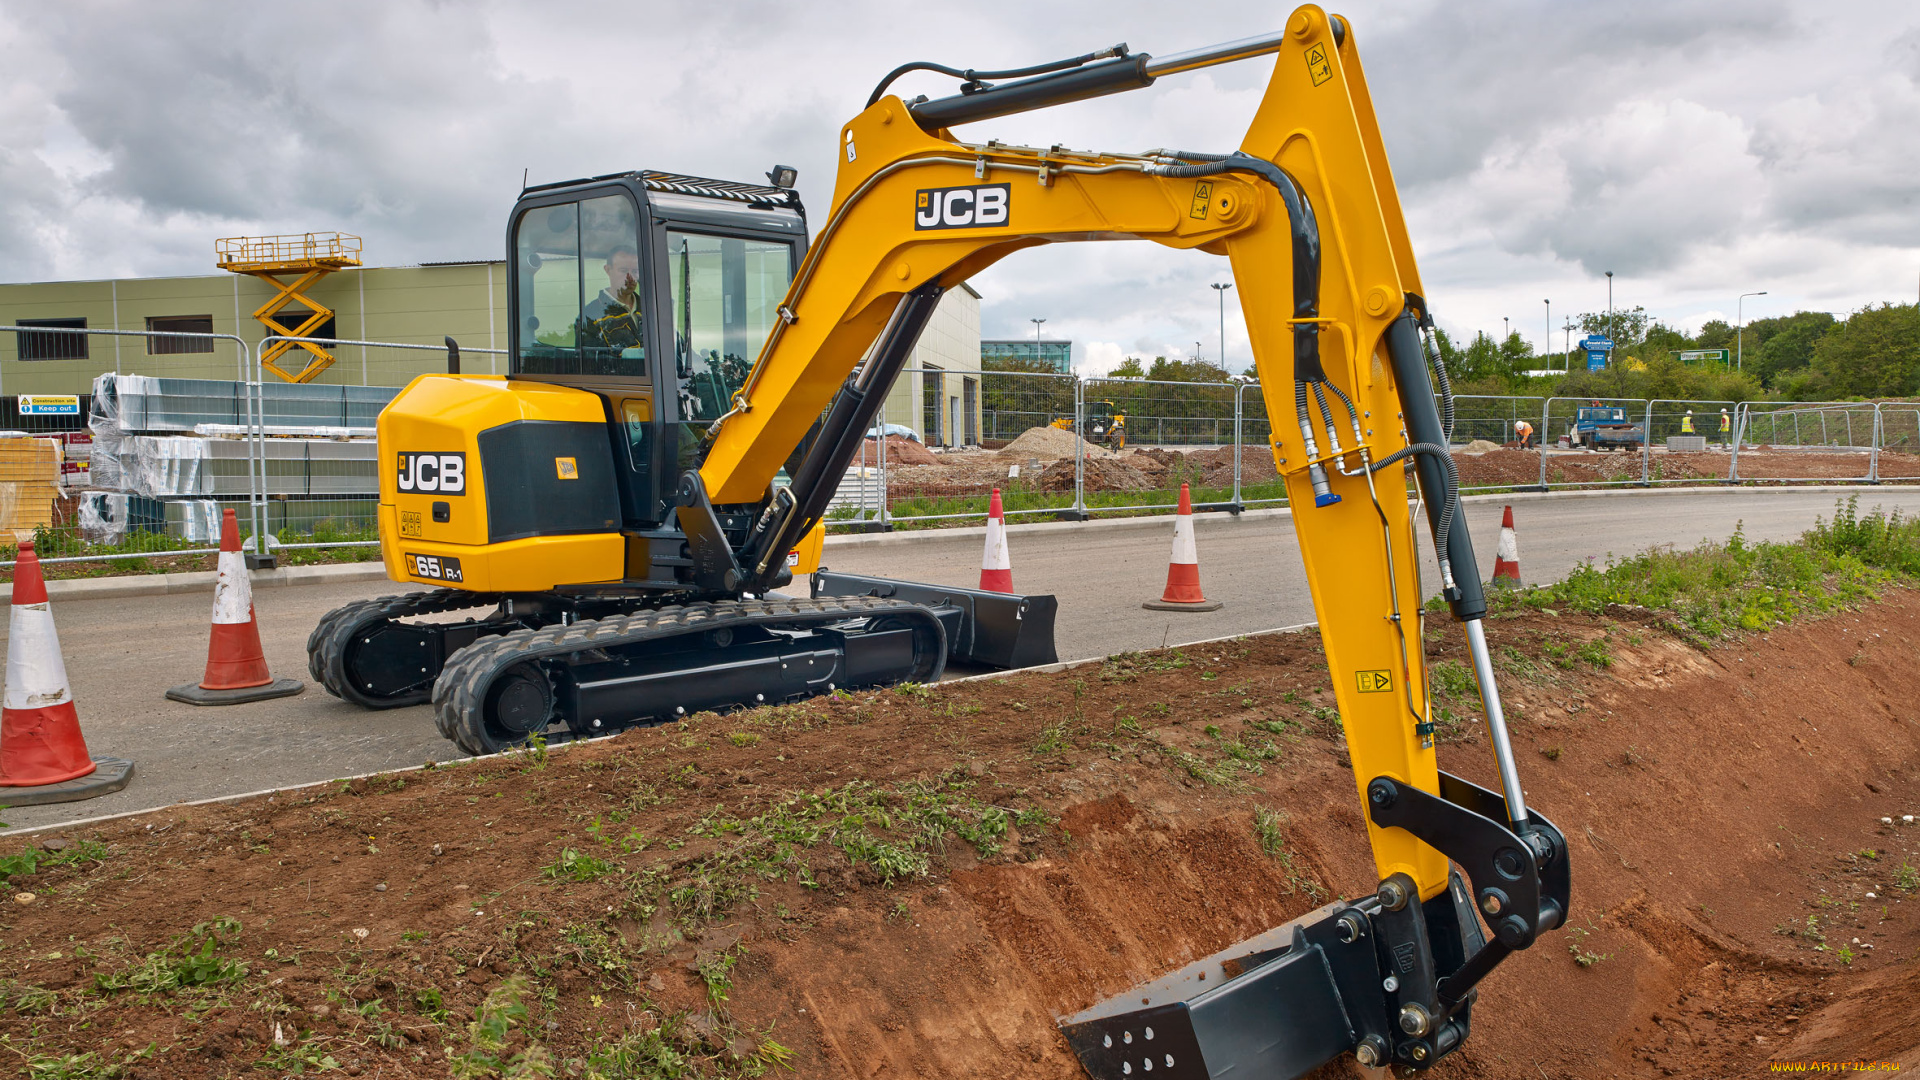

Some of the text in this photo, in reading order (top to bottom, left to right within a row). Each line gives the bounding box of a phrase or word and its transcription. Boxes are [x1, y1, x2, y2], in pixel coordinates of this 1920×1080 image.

[917, 187, 1007, 227] JCB
[398, 455, 464, 492] JCB
[416, 556, 463, 580] 65 R-1
